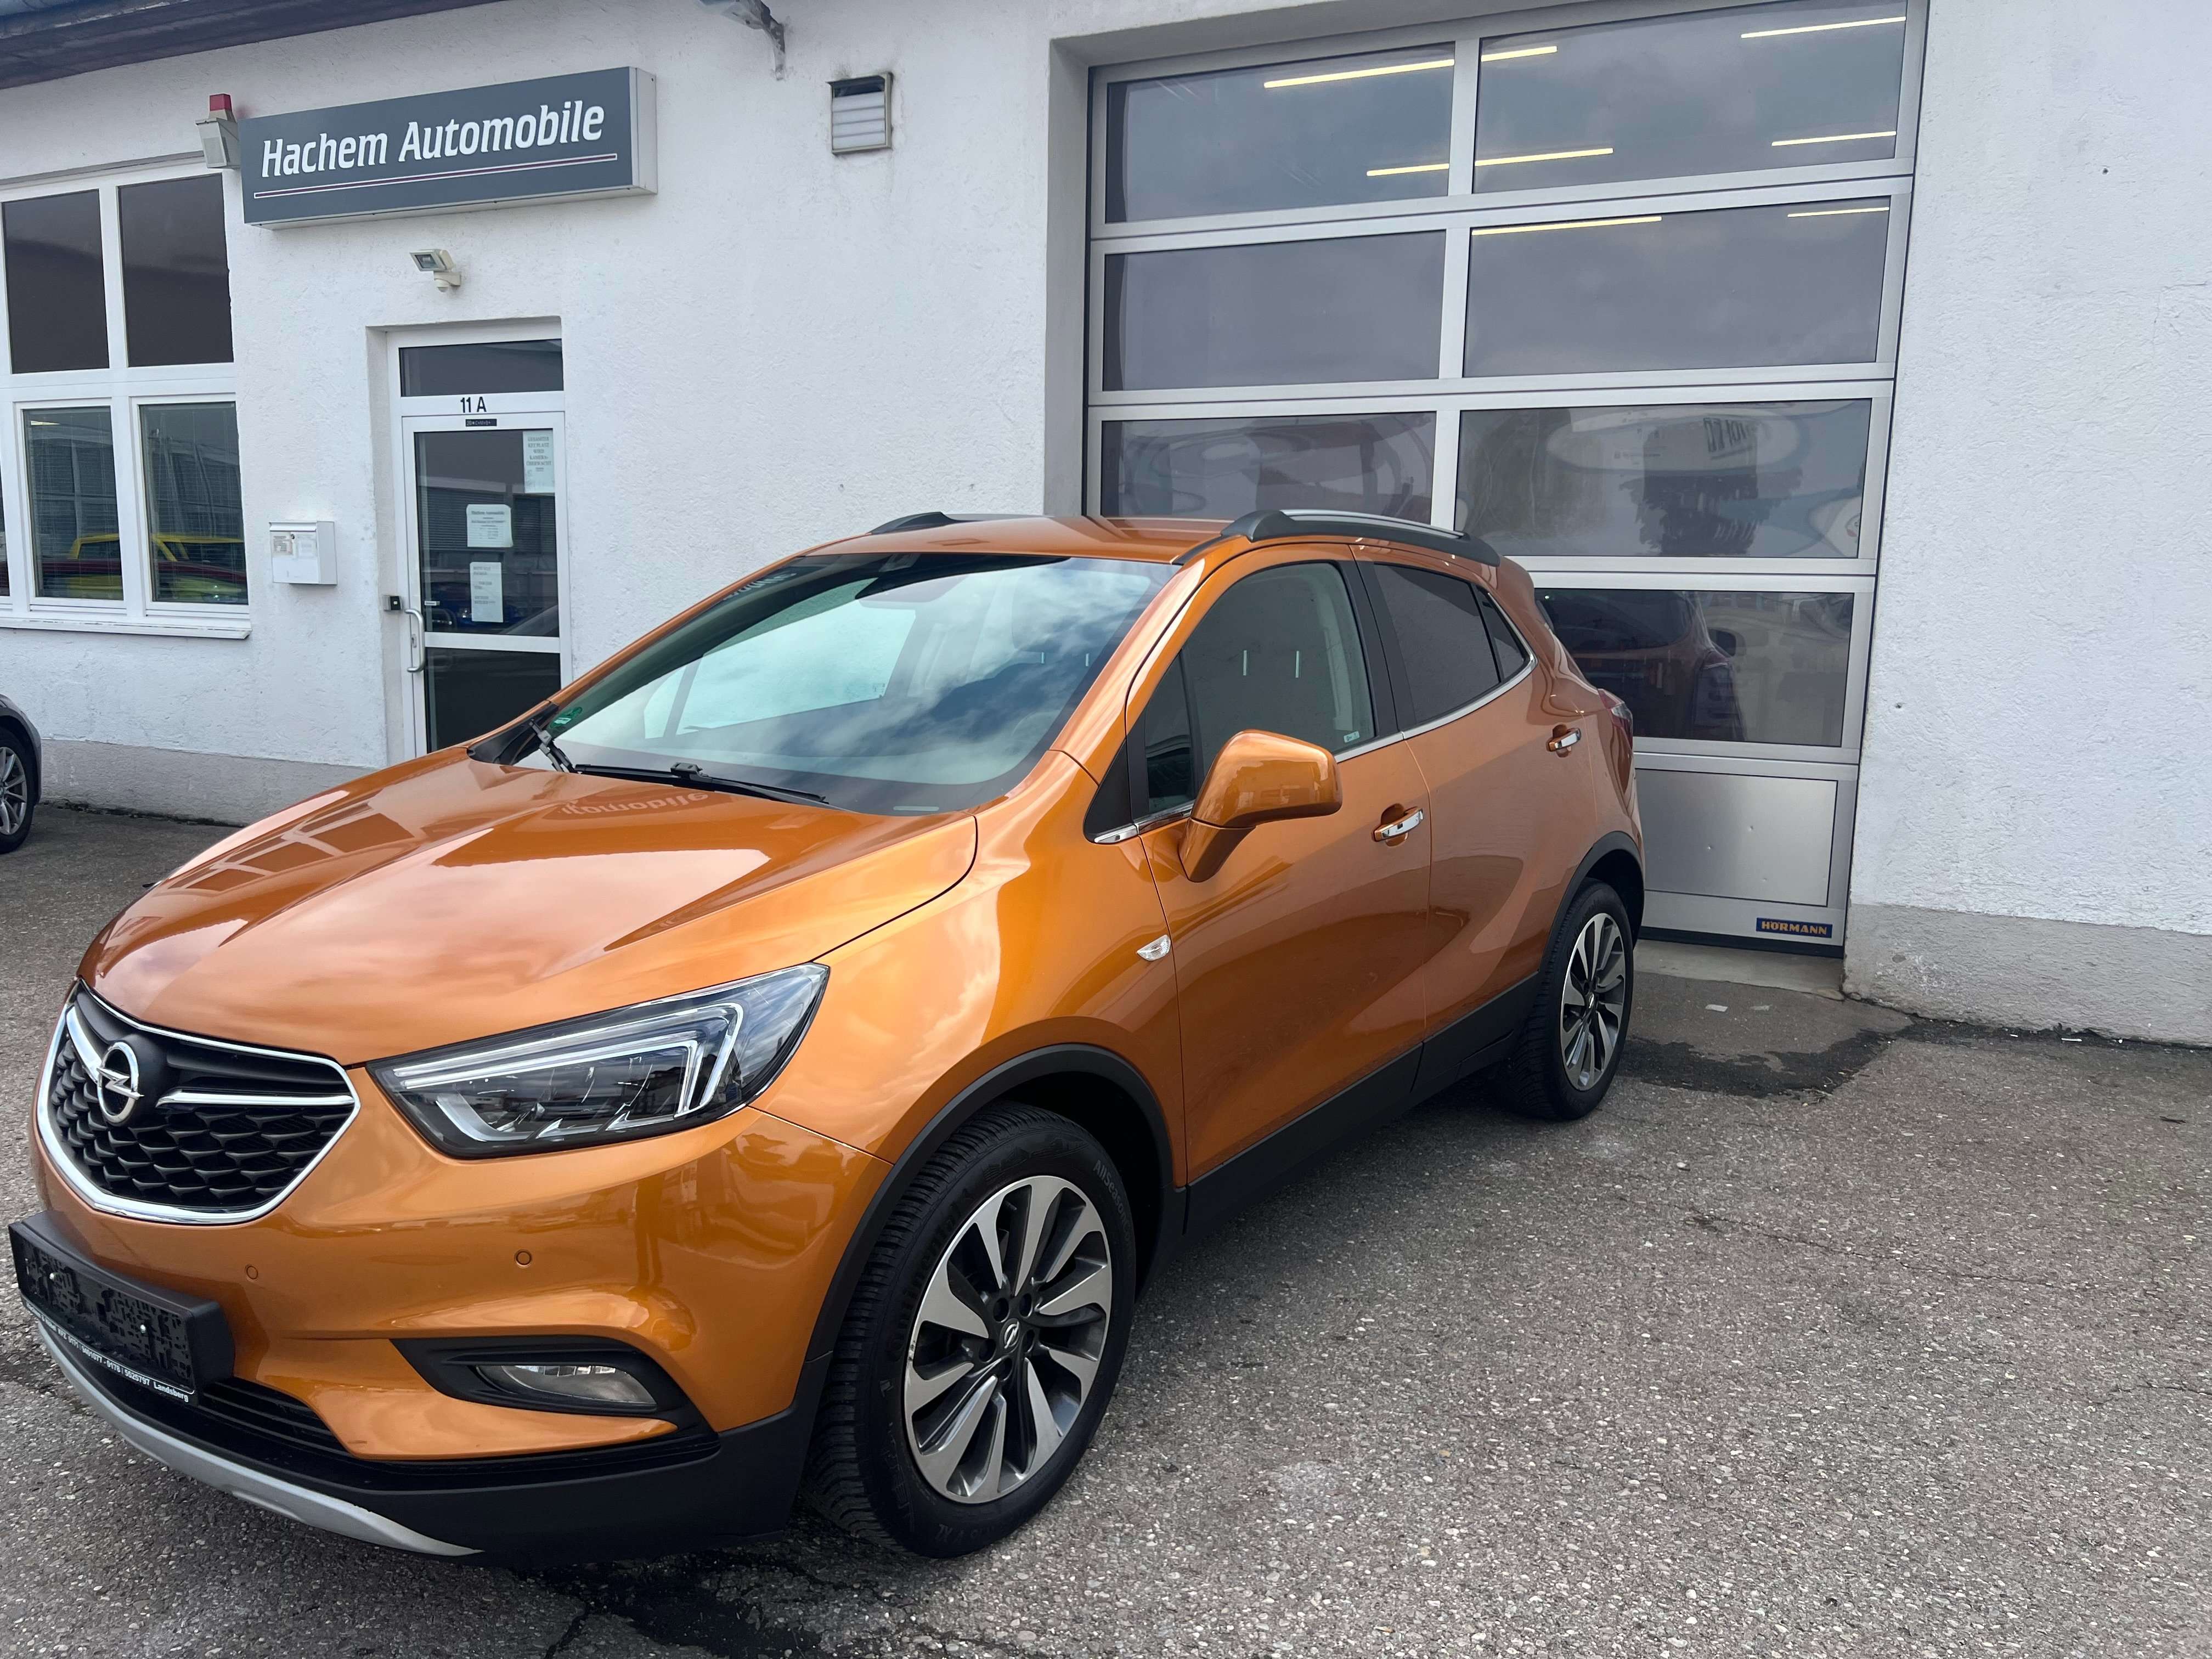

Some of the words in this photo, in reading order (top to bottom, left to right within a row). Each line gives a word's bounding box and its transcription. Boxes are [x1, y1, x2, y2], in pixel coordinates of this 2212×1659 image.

[262, 133, 388, 177] Hachem
[398, 100, 605, 162] Automobile
[460, 397, 471, 413] 11
[477, 396, 487, 413] A
[153, 1381, 189, 1403] Landsberg
